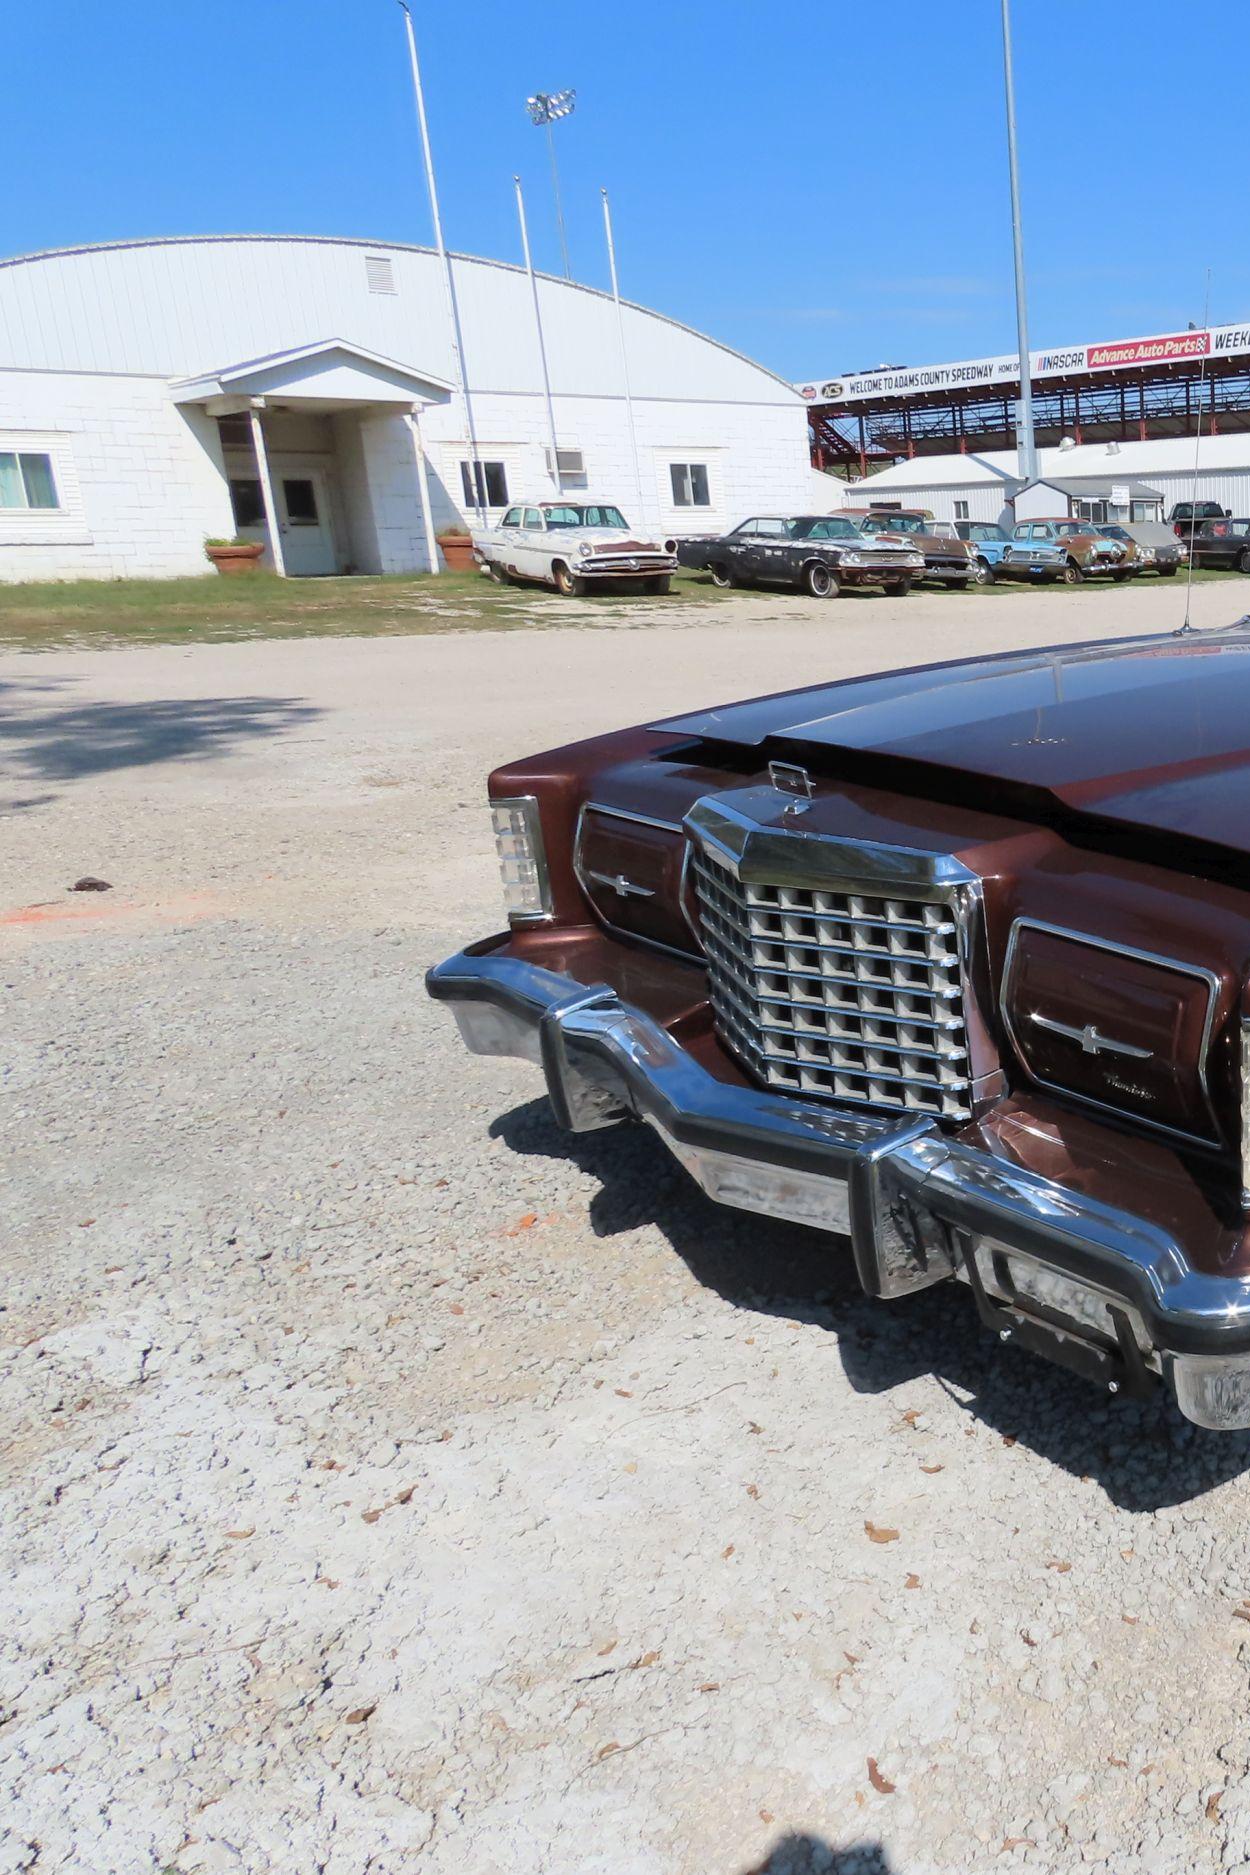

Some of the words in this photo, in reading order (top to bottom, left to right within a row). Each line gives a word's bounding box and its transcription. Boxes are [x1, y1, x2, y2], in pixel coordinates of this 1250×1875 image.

[1047, 352, 1084, 370] NASCAR
[1090, 347, 1136, 366] Advance
[1135, 343, 1164, 357] Auto
[1164, 338, 1199, 356] Parts
[998, 364, 1013, 373] HOME
[849, 380, 883, 395] WELCOME
[883, 377, 894, 390] TO
[894, 373, 919, 389] ADAMS
[920, 370, 951, 384] COUNTY
[951, 363, 994, 383] SPEEDWAY
[823, 384, 841, 398] ACS
